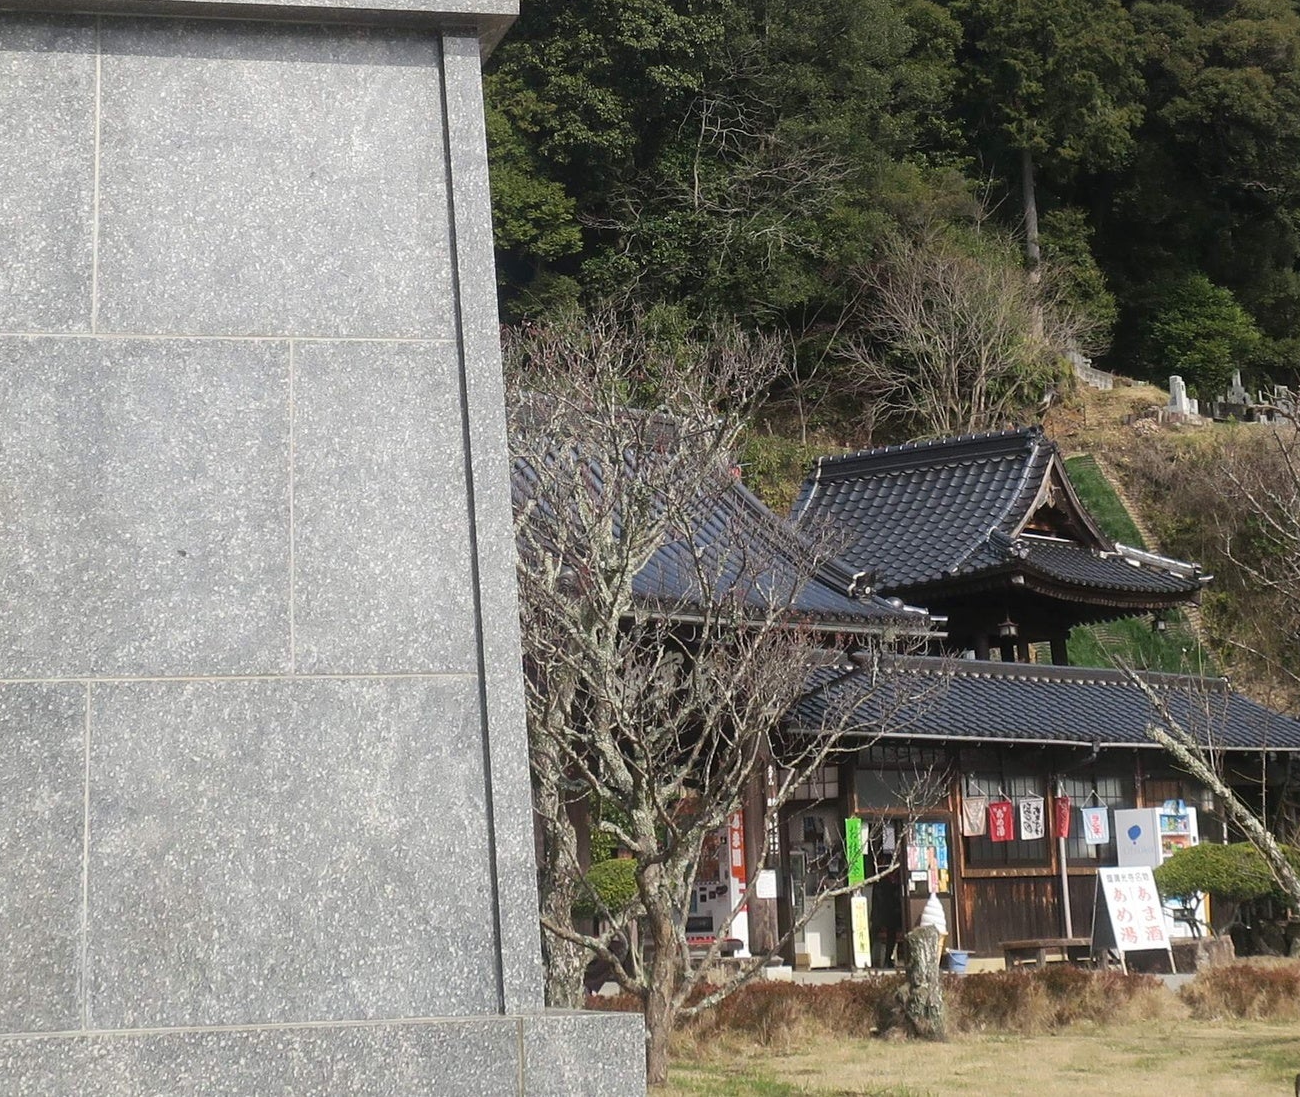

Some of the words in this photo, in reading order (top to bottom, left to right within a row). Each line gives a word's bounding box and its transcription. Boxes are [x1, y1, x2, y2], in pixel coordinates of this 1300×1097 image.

[1114, 887, 1138, 944] あめ湯
[1138, 886, 1164, 942] あま酒
